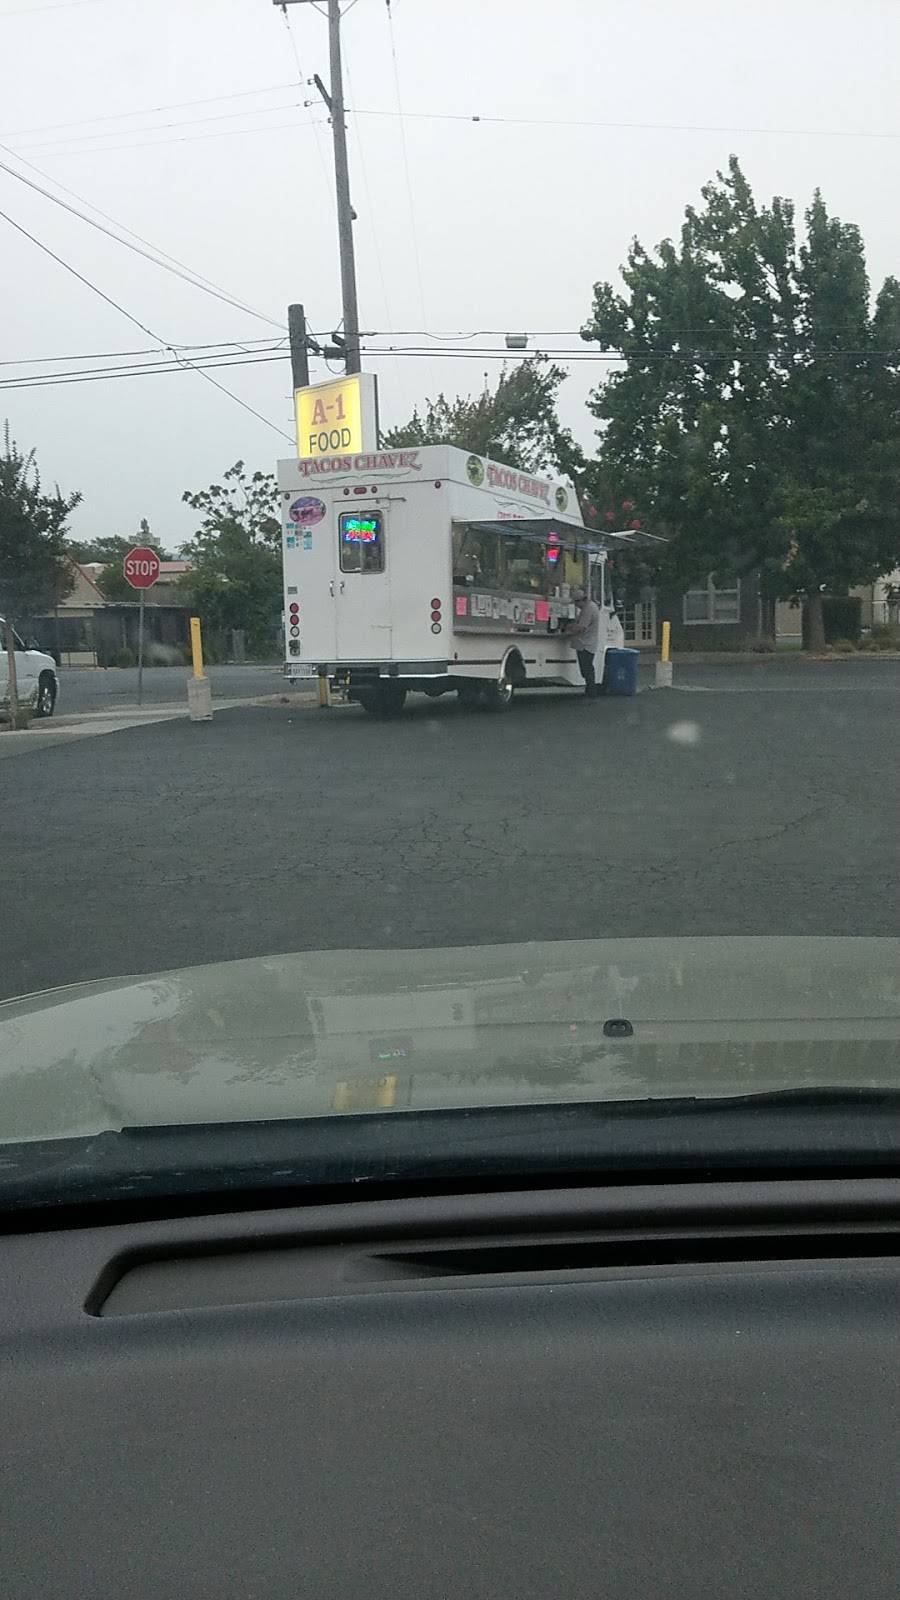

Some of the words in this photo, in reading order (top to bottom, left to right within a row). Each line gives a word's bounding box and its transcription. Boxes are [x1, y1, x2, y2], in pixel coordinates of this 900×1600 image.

[311, 393, 346, 426] A-1
[309, 427, 351, 453] FOOD
[298, 456, 352, 477] TACOS
[354, 451, 422, 471] CHAVEZ
[487, 464, 518, 491] TACOS
[126, 560, 158, 576] STOP
